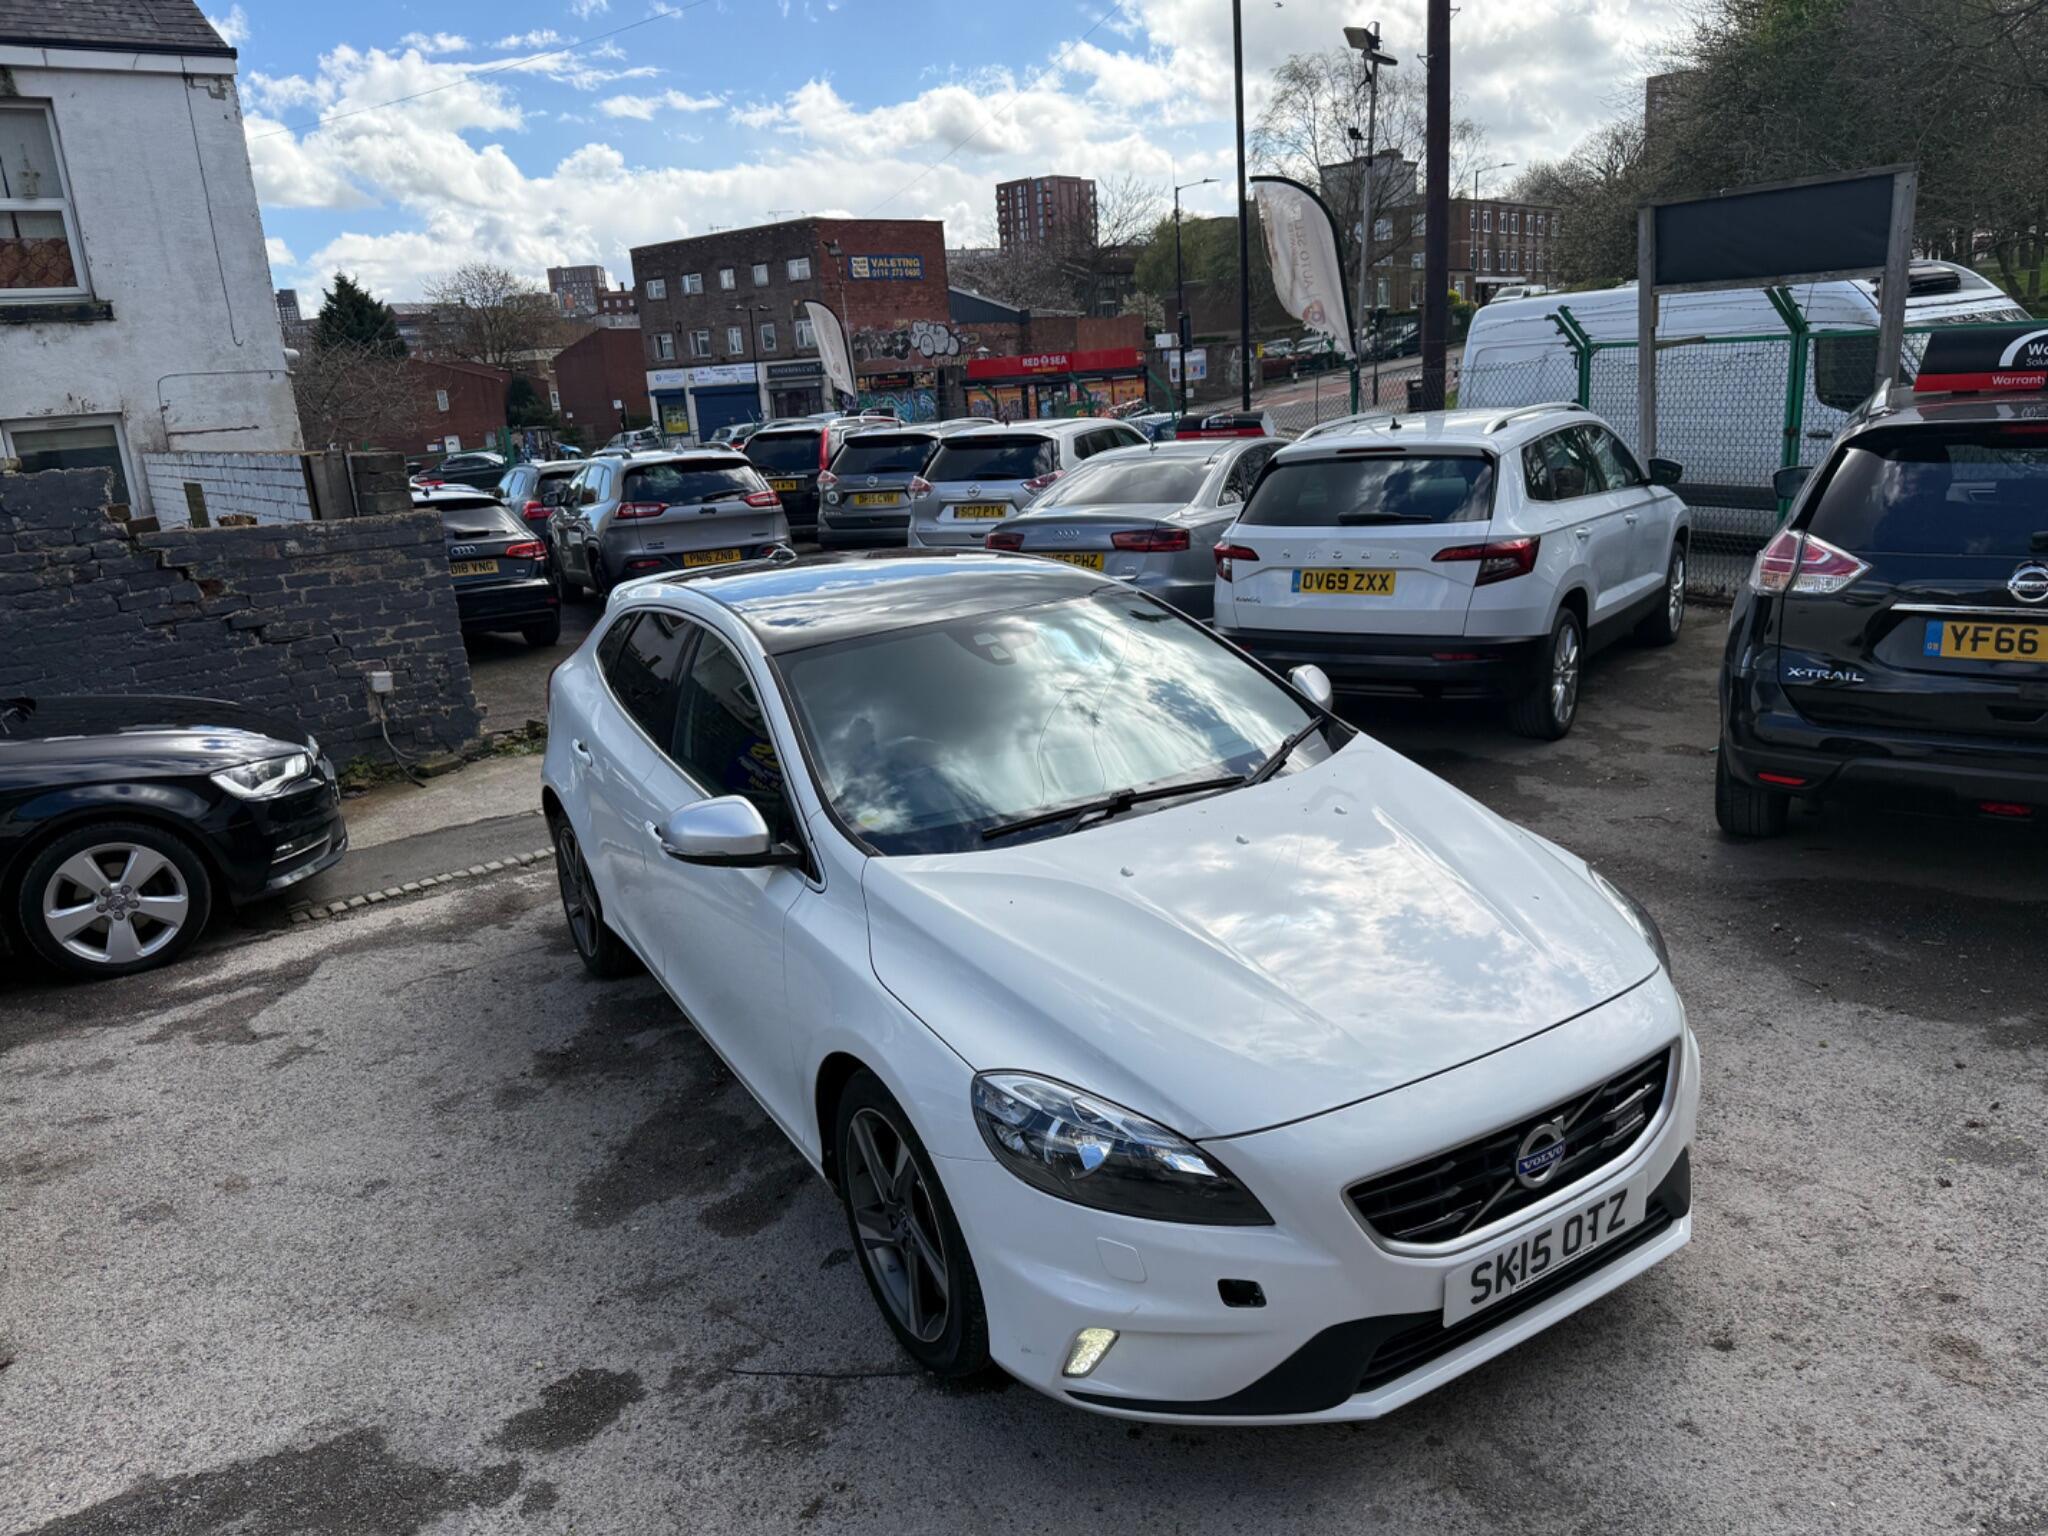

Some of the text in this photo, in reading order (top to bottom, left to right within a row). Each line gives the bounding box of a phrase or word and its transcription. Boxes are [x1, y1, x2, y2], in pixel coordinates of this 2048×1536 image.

[871, 257, 920, 268] VALETING
[1022, 355, 1067, 367] RED SEA
[1992, 375, 2046, 386] Warranty
[470, 561, 494, 572] VNG
[1074, 553, 1098, 568] PHZ
[1303, 572, 1390, 591] OV69 ZXX
[1950, 624, 2039, 655] YF66
[1788, 667, 1865, 682] X-TRAIL
[1522, 1144, 1563, 1170] VOLVO
[1471, 1228, 1552, 1305] SK15
[1563, 1189, 1628, 1257] OTZ
